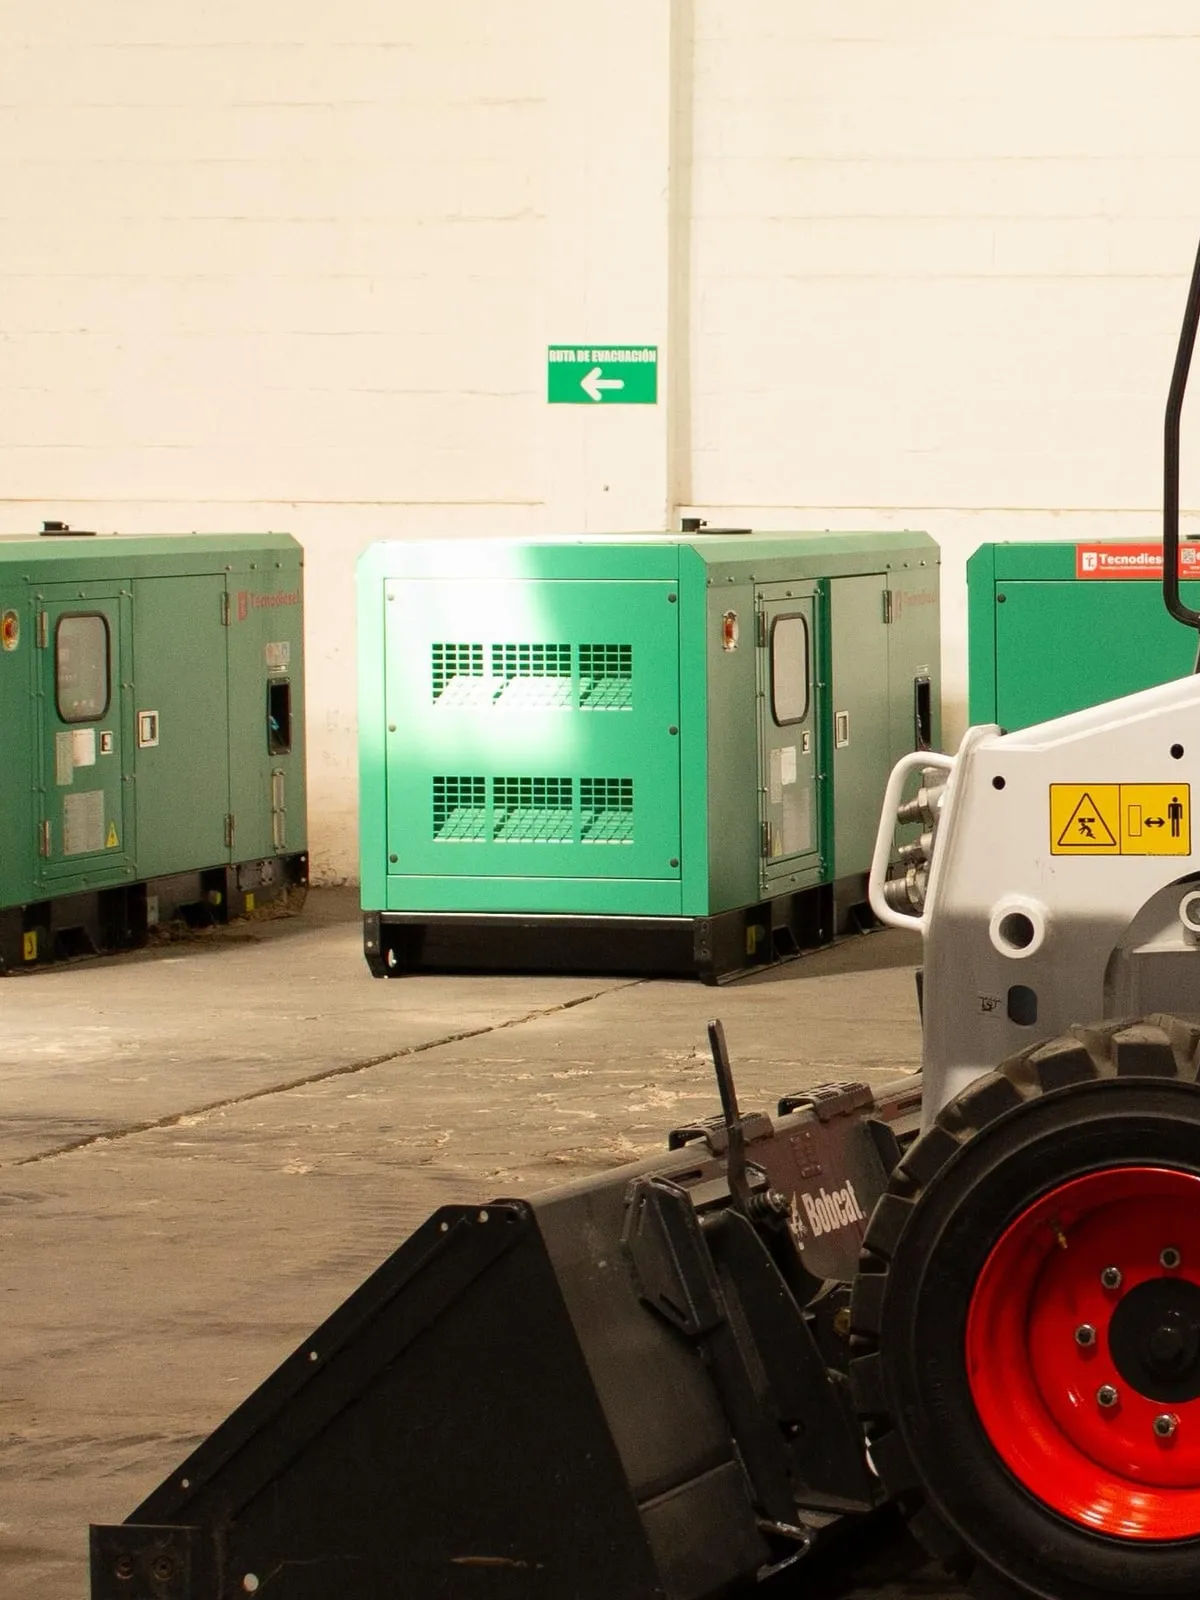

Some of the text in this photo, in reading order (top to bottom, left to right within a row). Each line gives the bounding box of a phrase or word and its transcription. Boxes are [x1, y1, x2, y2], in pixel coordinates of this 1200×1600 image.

[549, 348, 657, 363] RUTA DE EVACUACIÓN
